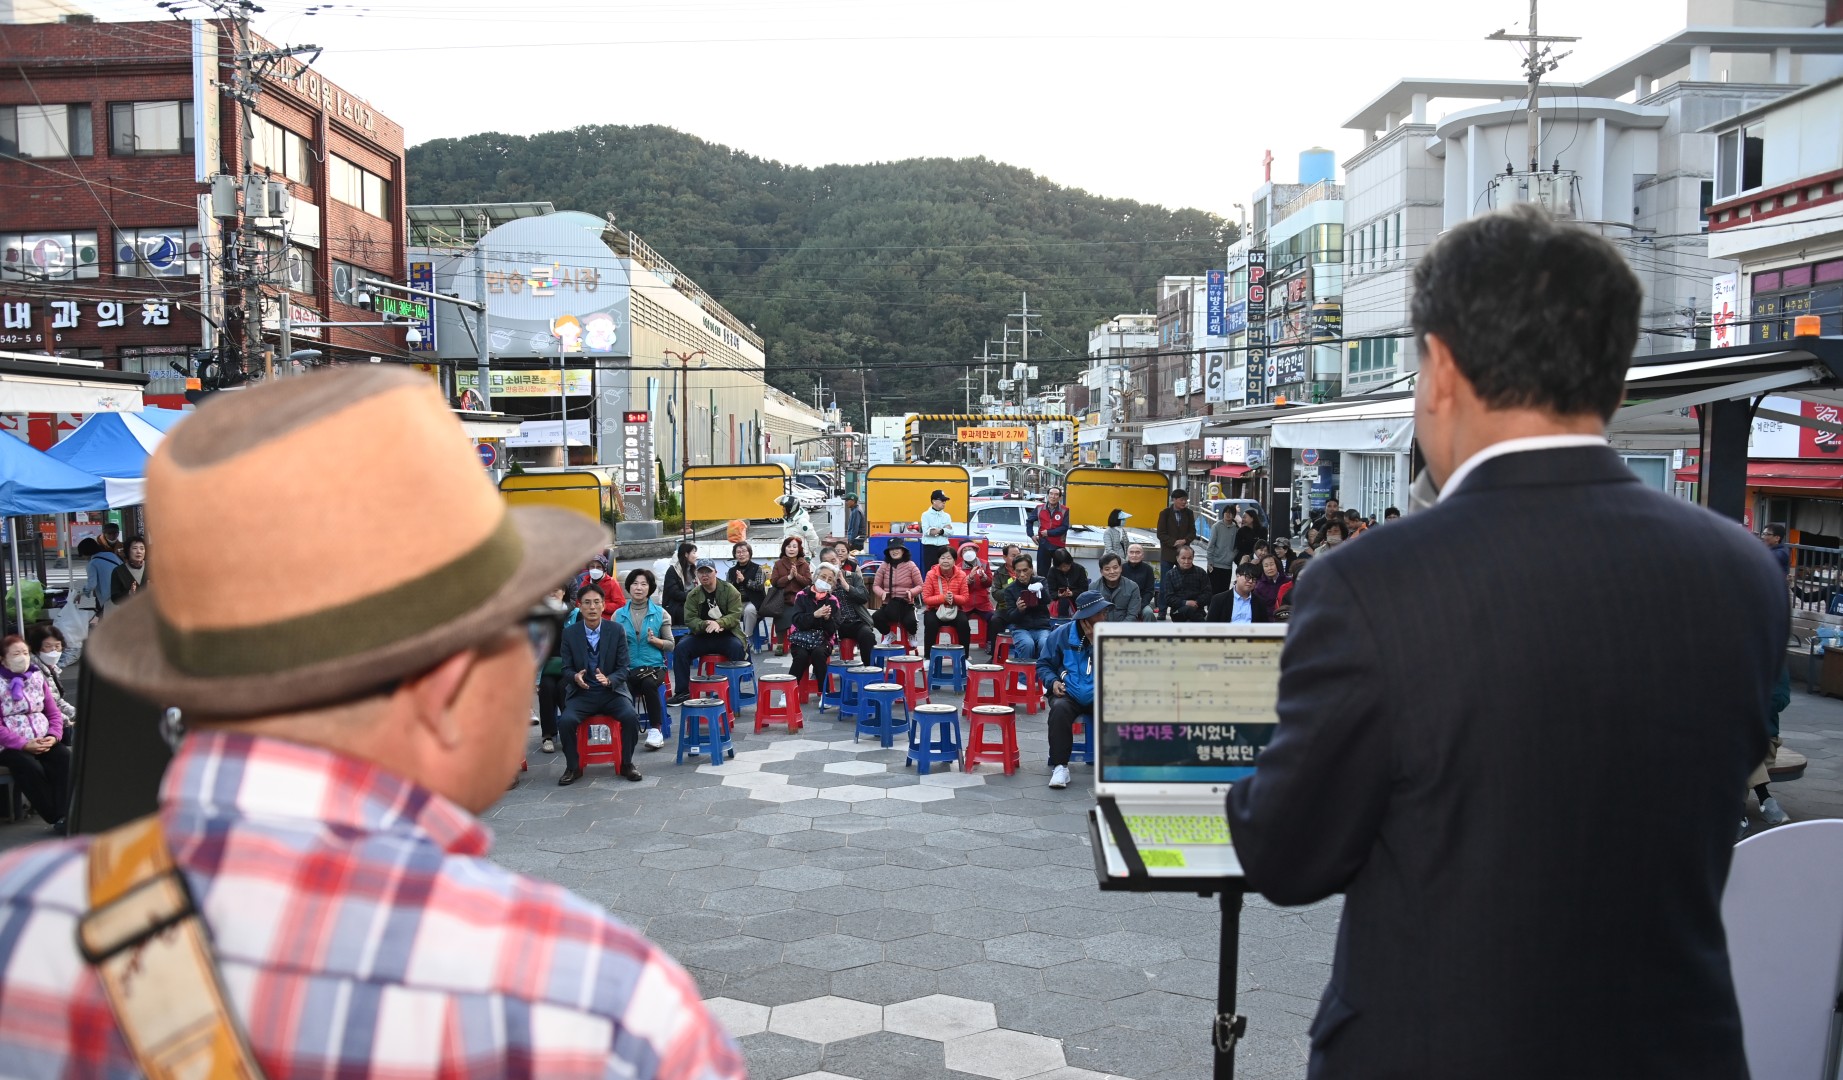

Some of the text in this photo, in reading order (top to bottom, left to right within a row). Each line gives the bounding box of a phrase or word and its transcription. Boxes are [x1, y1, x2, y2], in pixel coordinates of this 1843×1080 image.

[1249, 252, 1265, 263] OX
[486, 261, 601, 297] 반송큰시장
[1209, 296, 1222, 335] 방주교회
[0, 333, 62, 344] 542-566
[961, 430, 1025, 439] 통과제한높이 2.7M
[1116, 724, 1236, 741] 낙엽지듯 가시었나
[1196, 745, 1254, 761] 행복했던
